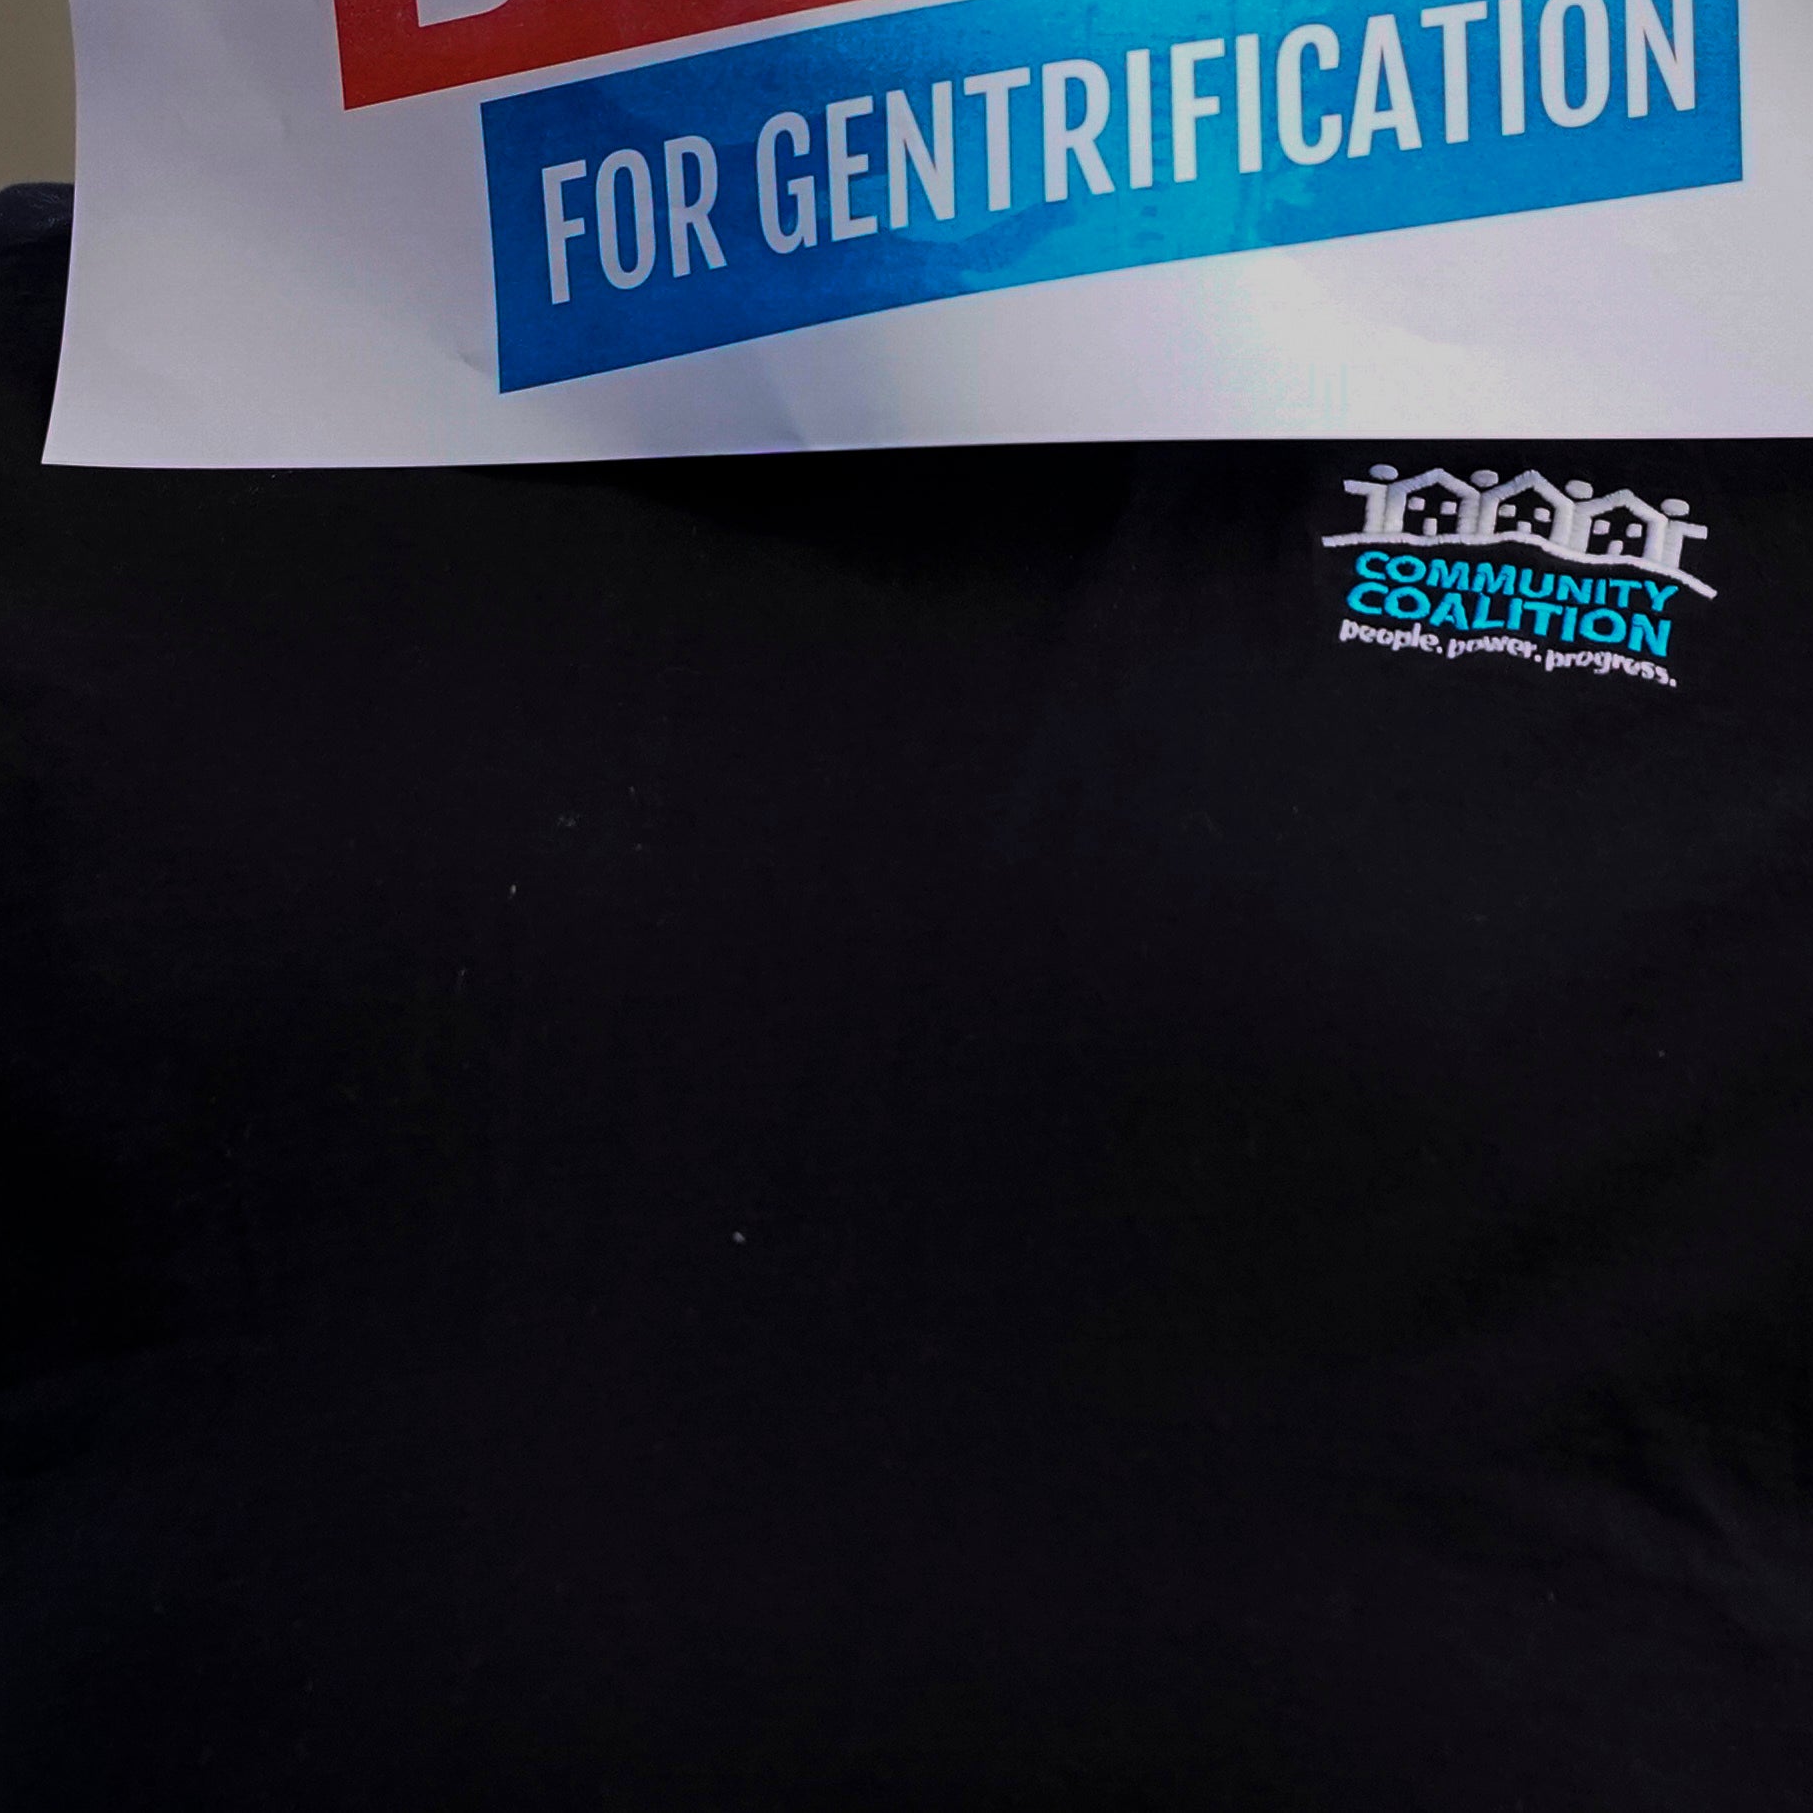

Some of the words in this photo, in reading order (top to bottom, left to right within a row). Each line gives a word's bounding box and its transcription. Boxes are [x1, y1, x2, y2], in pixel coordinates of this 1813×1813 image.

[541, 134, 723, 305] FOR
[1355, 551, 1678, 611] COMMUNITY
[1339, 619, 1443, 654] people.
[1447, 635, 1542, 662] power.
[1544, 649, 1677, 687] progress.
[1346, 582, 1672, 657] COALITION
